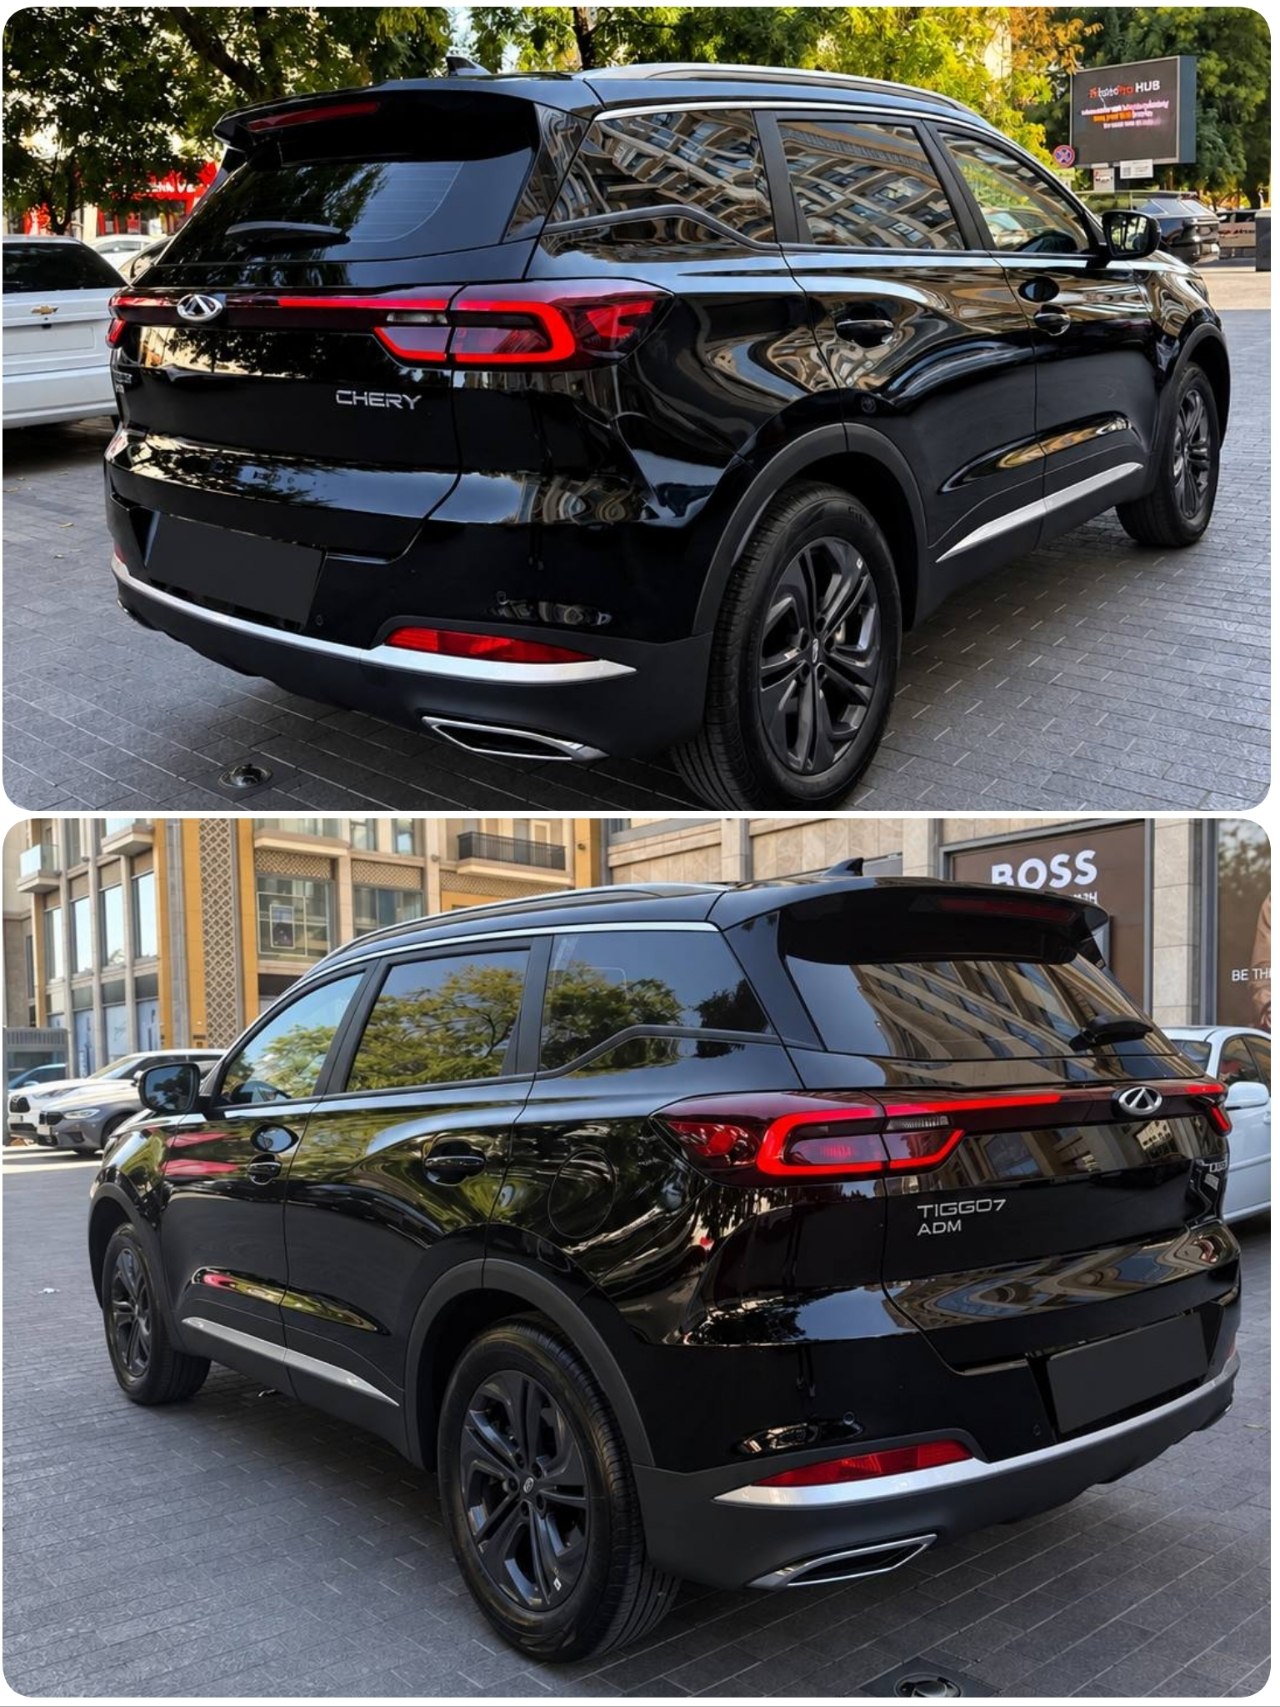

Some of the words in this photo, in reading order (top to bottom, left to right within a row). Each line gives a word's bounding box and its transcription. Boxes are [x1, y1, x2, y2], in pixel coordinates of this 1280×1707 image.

[1135, 80, 1161, 93] HUB
[335, 389, 422, 411] CHERY
[991, 849, 1098, 890] BOSS
[1231, 967, 1250, 982] BE
[916, 1219, 962, 1237] ADM
